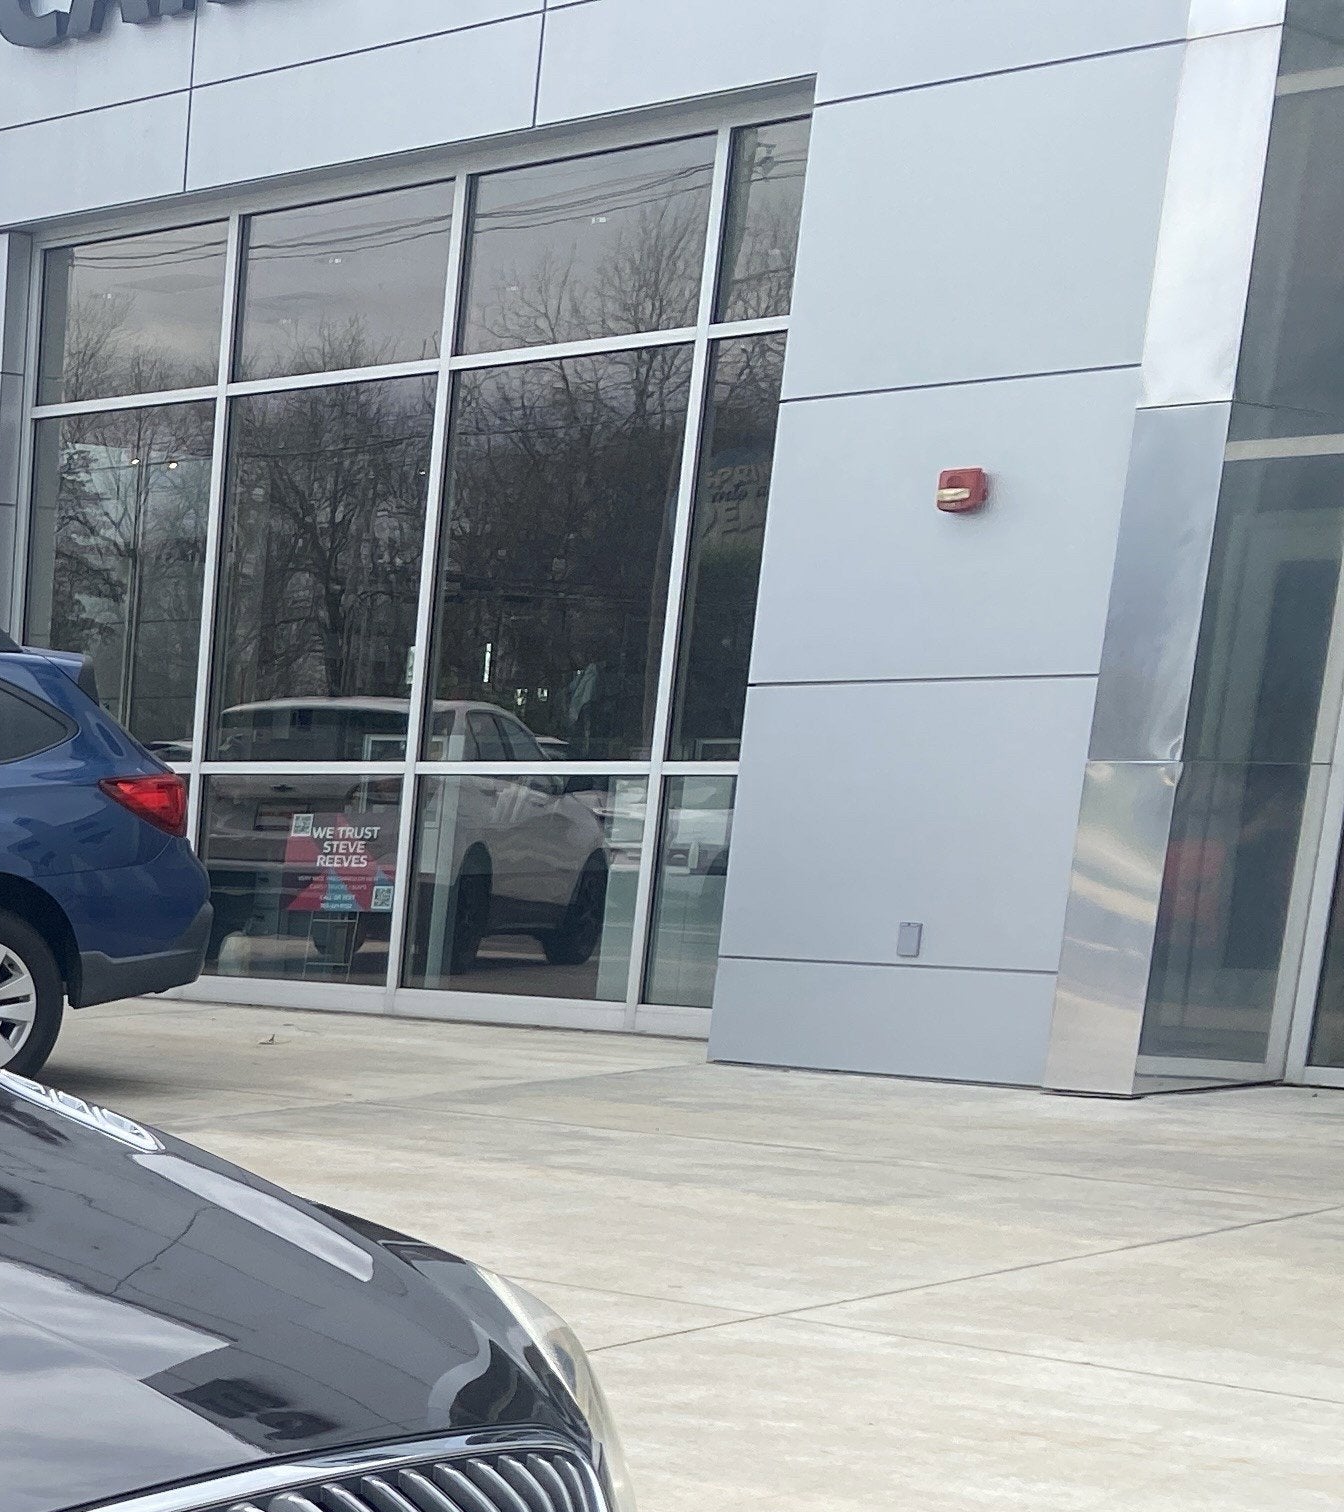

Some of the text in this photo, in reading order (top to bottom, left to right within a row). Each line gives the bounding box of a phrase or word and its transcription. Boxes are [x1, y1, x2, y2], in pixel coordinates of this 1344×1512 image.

[312, 826, 380, 839] WE TRUST
[323, 841, 367, 853] STEVE
[316, 854, 369, 867] REEVES
